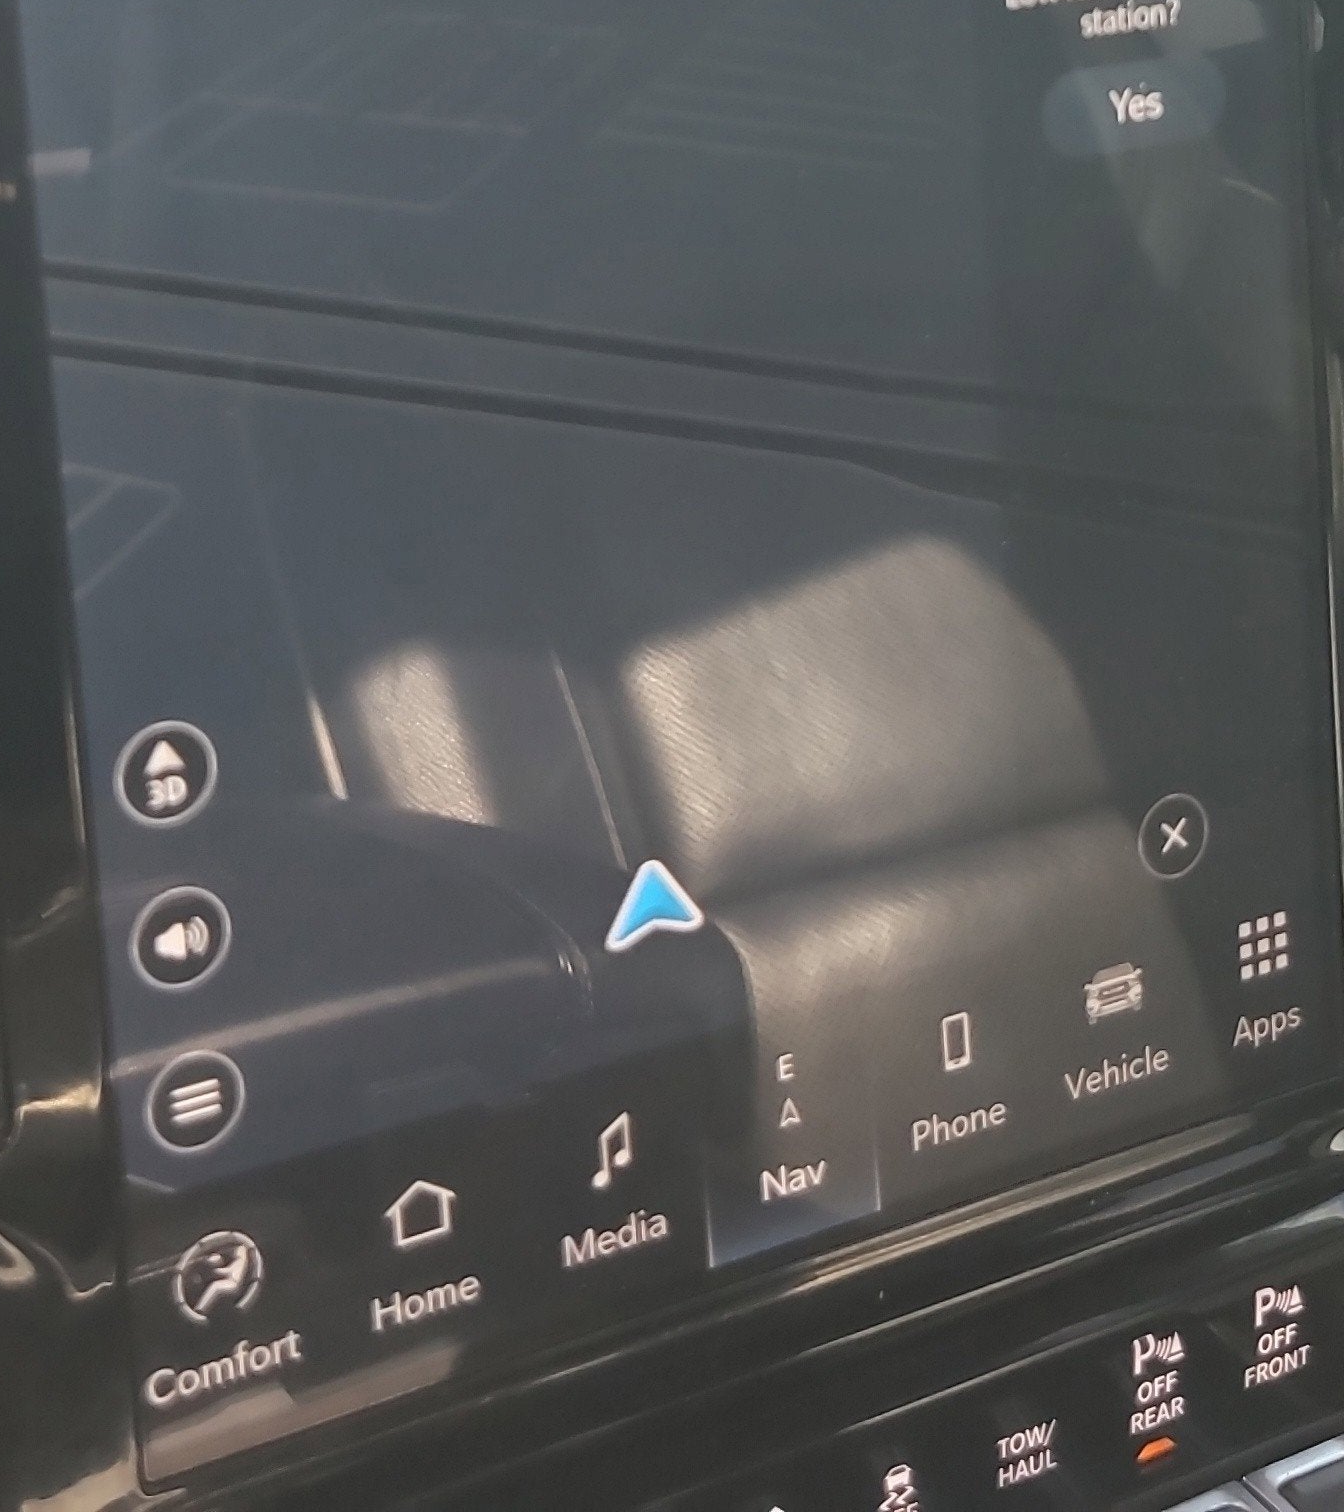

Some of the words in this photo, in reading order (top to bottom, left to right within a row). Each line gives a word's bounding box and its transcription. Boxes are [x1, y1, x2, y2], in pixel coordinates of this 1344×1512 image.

[1109, 87, 1164, 124] Yes
[145, 774, 188, 811] 3D
[1233, 1006, 1301, 1048] Apps
[777, 1053, 795, 1081] E
[1064, 1046, 1169, 1100] Vehicle
[912, 1100, 1007, 1151] Phone
[760, 1159, 827, 1202] Nav
[561, 1209, 669, 1268] Media
[370, 1274, 481, 1332] Home
[1258, 1323, 1297, 1354] OFF
[145, 1330, 302, 1406] Comfort
[1137, 1370, 1177, 1403] OFF
[1244, 1345, 1310, 1388] FRONT
[1131, 1397, 1185, 1435] REAR
[996, 1419, 1056, 1459] TOW/
[998, 1449, 1057, 1488] HAUL
